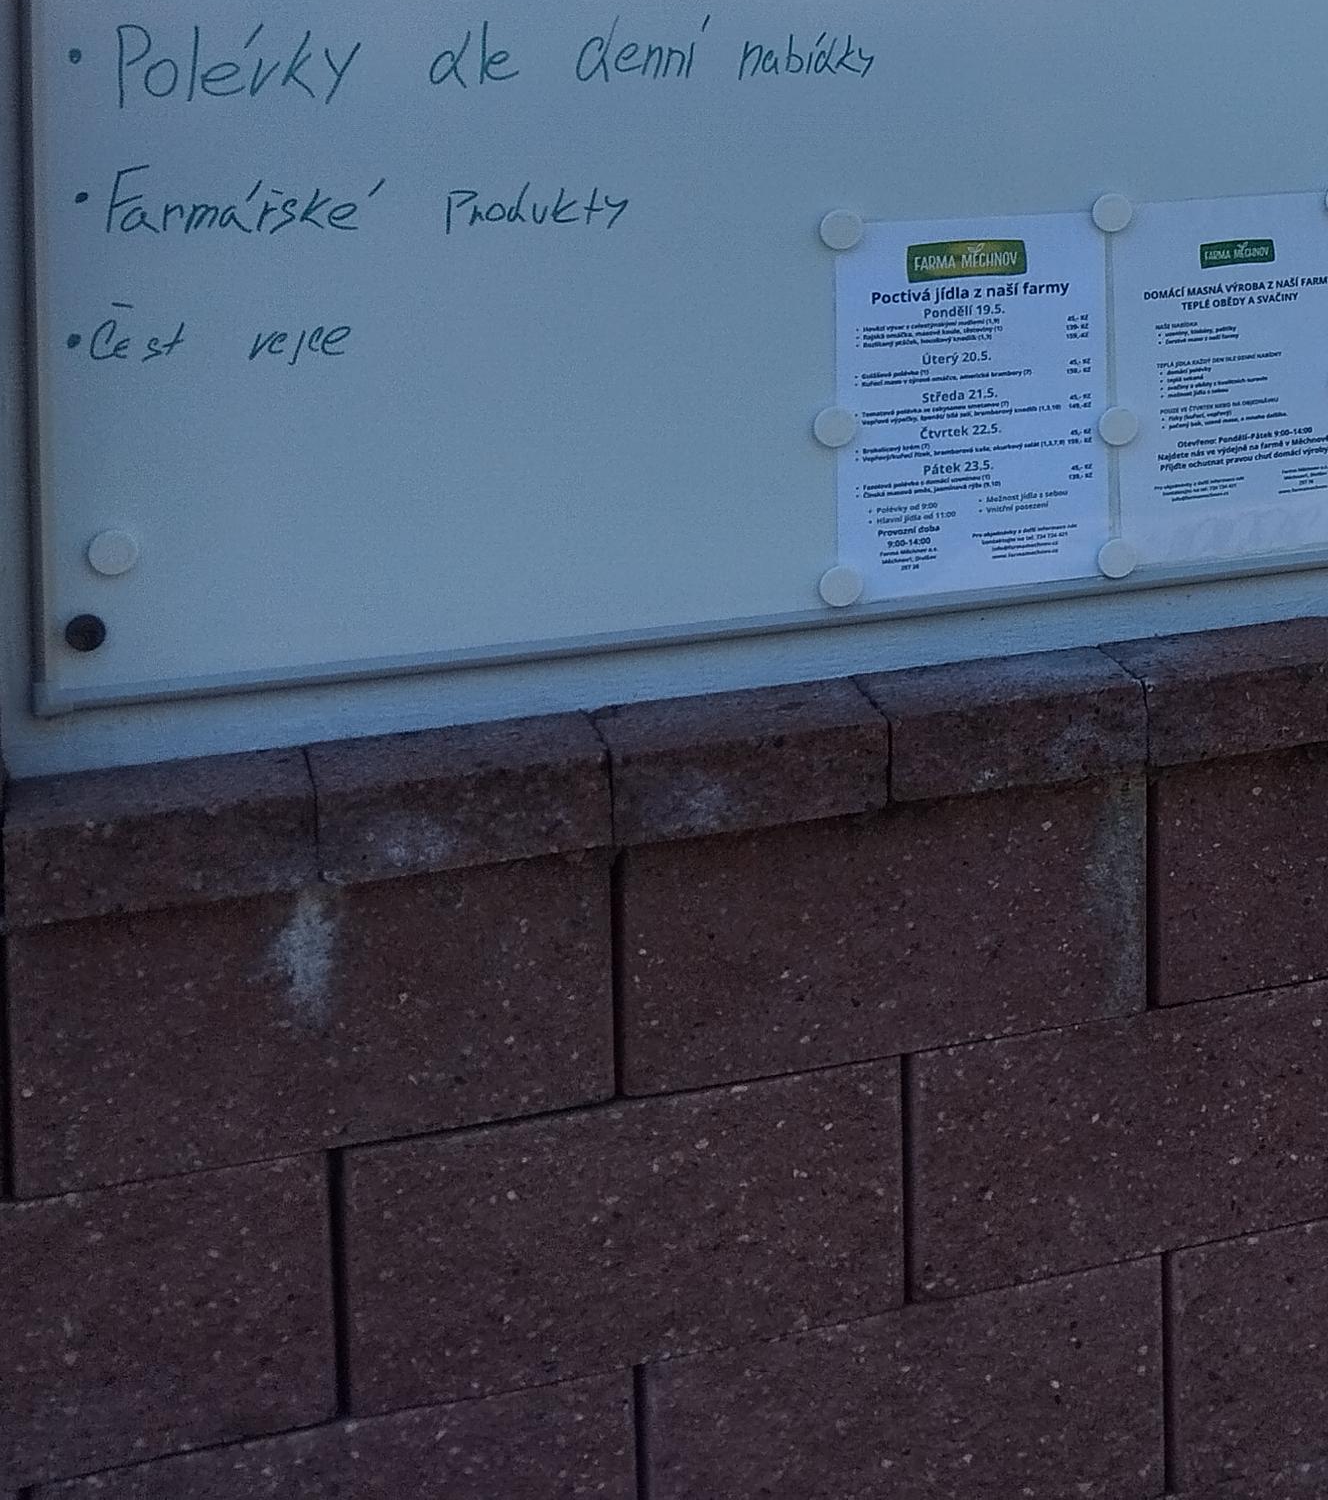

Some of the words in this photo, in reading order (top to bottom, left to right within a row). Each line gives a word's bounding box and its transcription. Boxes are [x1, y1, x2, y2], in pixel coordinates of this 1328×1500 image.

[115, 21, 362, 109] Polévky
[914, 256, 956, 272] FARMA
[870, 287, 931, 304] Poctivá
[933, 286, 970, 304] jídla
[973, 287, 982, 298] z
[986, 282, 1019, 297] naší
[1022, 281, 1069, 296] farmy
[1143, 286, 1185, 300] DOMÁCÍ
[1186, 283, 1224, 296] MASNÁ
[1224, 281, 1265, 292] VÝROBA
[1266, 280, 1274, 290] Z
[1275, 276, 1299, 288] NAŠÍ
[1180, 298, 1210, 310] TEPLÉ
[1211, 295, 1245, 308] OBĚDY
[1247, 295, 1255, 305] A
[1256, 291, 1298, 304] SVAČINY
[923, 304, 973, 318] Pondělí
[975, 303, 1005, 315] 19.5.
[921, 351, 959, 366] Úterý
[961, 350, 992, 362] 20.5.
[921, 389, 965, 403] Středa
[967, 387, 998, 400] 21.5.
[919, 425, 969, 439] Čtvrtek
[971, 422, 1002, 435] 22.5.
[923, 462, 961, 475] Pátek
[964, 459, 994, 472] 23.5.
